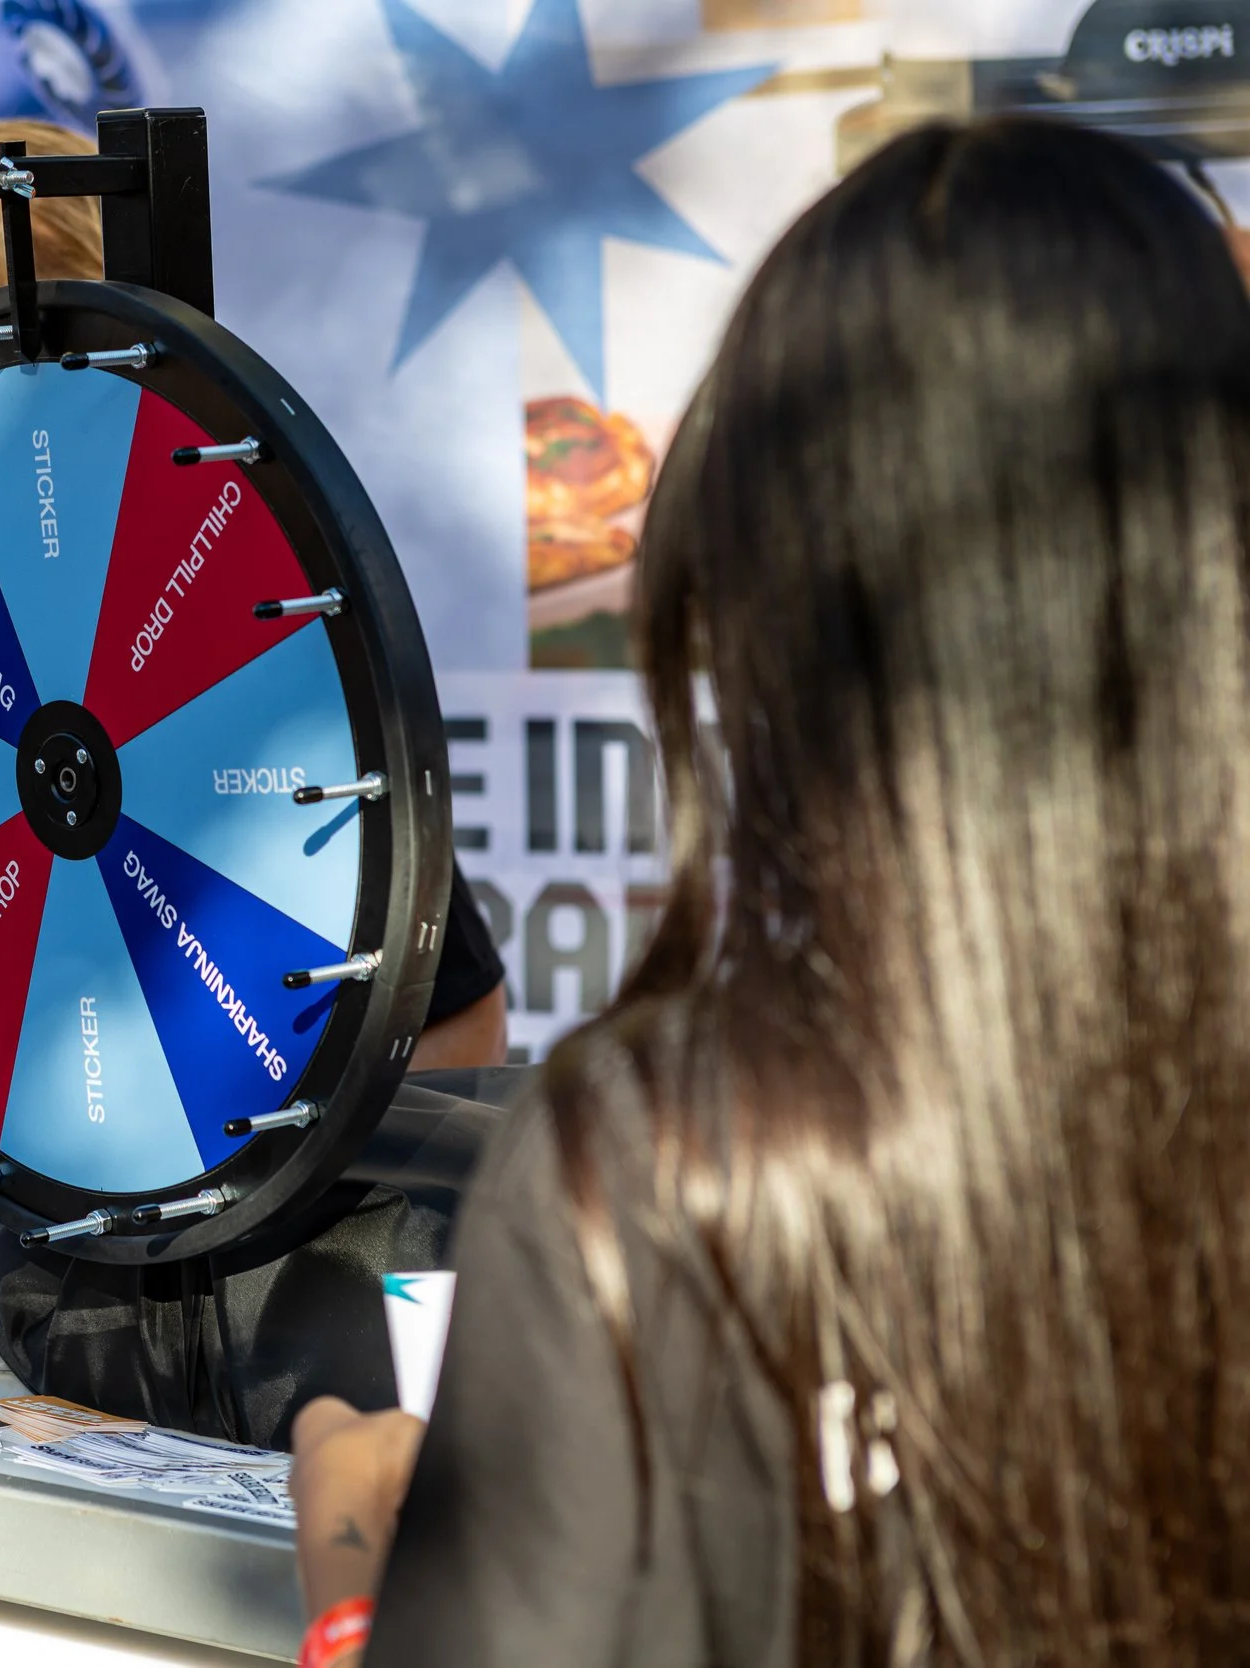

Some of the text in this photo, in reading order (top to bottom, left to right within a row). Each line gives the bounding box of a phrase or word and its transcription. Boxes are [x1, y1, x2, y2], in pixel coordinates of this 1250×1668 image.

[31, 428, 60, 560] STICKER
[130, 597, 175, 673] DROP
[212, 766, 306, 795] STICKER
[123, 850, 287, 1082] SHARKNINJA SWAG
[77, 997, 106, 1125] STICKER
